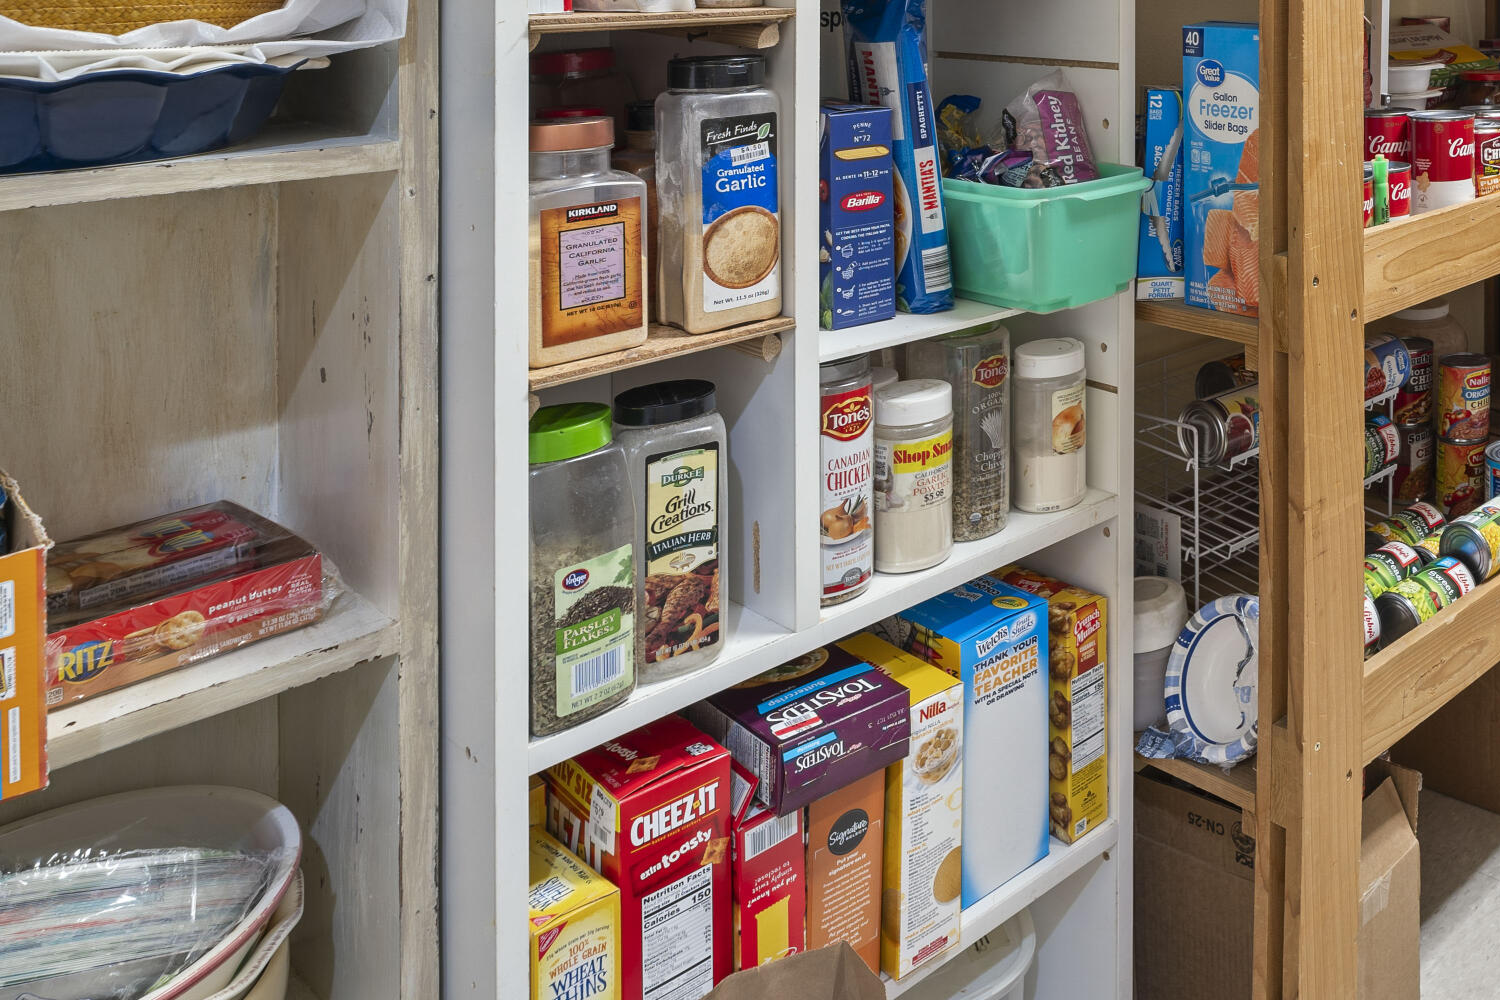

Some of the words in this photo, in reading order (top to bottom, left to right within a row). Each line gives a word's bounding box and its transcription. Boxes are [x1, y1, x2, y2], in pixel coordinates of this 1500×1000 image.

[1185, 31, 1199, 46] 40
[1199, 66, 1220, 77] Great
[1203, 73, 1220, 82] Value
[1213, 92, 1238, 103] Gallon
[919, 90, 928, 139] SPAGHETTI
[1199, 98, 1254, 121] Freezer
[706, 127, 732, 143] Fresh
[734, 121, 759, 136] Finds
[852, 121, 873, 131] PENNE
[1048, 95, 1072, 152] Kidney
[1204, 119, 1225, 132] Slider
[1227, 121, 1248, 134] Bags
[740, 143, 762, 154] $4.50
[716, 163, 765, 177] Granulated
[863, 169, 879, 178] 11-12
[1062, 154, 1079, 185] Red
[715, 174, 767, 194] Garlic
[918, 159, 939, 211] MANTIA'S
[567, 204, 617, 220] KIRKLAND
[846, 195, 883, 208] Barilla
[565, 237, 618, 252] GRANULATED
[568, 246, 616, 260] CALIFORNIA
[577, 256, 607, 268] GARLIC
[713, 298, 724, 306] Net
[725, 296, 735, 304] Wt.
[736, 294, 747, 302] 11.5
[977, 361, 1008, 381] Tone's
[831, 405, 871, 429] Tone's
[826, 448, 870, 472] CANADIAN
[893, 449, 931, 466] Shop
[661, 468, 705, 487] DURKEE
[826, 465, 870, 492] CHICKEN
[664, 487, 697, 515] Grill
[923, 488, 945, 503] $5.98
[650, 500, 715, 535] Creations
[652, 535, 687, 556] ITALIAN
[687, 529, 713, 545] HERB
[565, 572, 589, 586] Kroger
[1427, 569, 1456, 597] Sweet
[208, 592, 247, 615] peanut
[248, 583, 283, 602] butter
[563, 614, 617, 641] PARSLEY
[1012, 620, 1035, 638] Snacks
[1015, 614, 1031, 628] Fruit
[1073, 608, 1100, 636] Crunch
[563, 626, 612, 650] FLAKES
[976, 626, 1010, 657] Welch's
[1075, 619, 1101, 647] Munch
[57, 639, 115, 682] RITZ
[974, 651, 1009, 672] THANK
[1012, 635, 1038, 654] YOUR
[973, 645, 1038, 685] FAVORITE
[1071, 672, 1092, 685] Nutrition
[1092, 664, 1105, 676] Facts
[974, 658, 1038, 697] TEACHER
[974, 693, 991, 706] WITH
[997, 678, 1021, 697] SPECIAL
[1022, 668, 1038, 682] NOTE
[571, 701, 582, 710] NET
[583, 699, 592, 707] WT
[767, 680, 827, 707] Buttercrisp
[986, 696, 995, 706] OR
[995, 683, 1025, 702] DRAWING
[1072, 692, 1090, 705] Calories
[919, 699, 947, 724] Nilla
[796, 739, 845, 774] TOASTEDS
[828, 817, 868, 848] Signature
[1187, 811, 1226, 836] CN-25
[639, 862, 663, 881] extra
[660, 827, 712, 871] toasty
[782, 860, 791, 869] to
[643, 879, 684, 905] Nutrition
[686, 866, 712, 884] Facts
[770, 866, 793, 884] simply
[772, 878, 785, 893] you
[786, 873, 798, 885] did
[747, 889, 771, 909] know?
[751, 882, 770, 895] twist
[643, 906, 680, 931] Calories
[691, 887, 712, 905] 150
[568, 938, 590, 957] 100%
[549, 955, 579, 980] WHOLE
[582, 941, 608, 962] GRAIN
[549, 953, 608, 996] WHEAT
